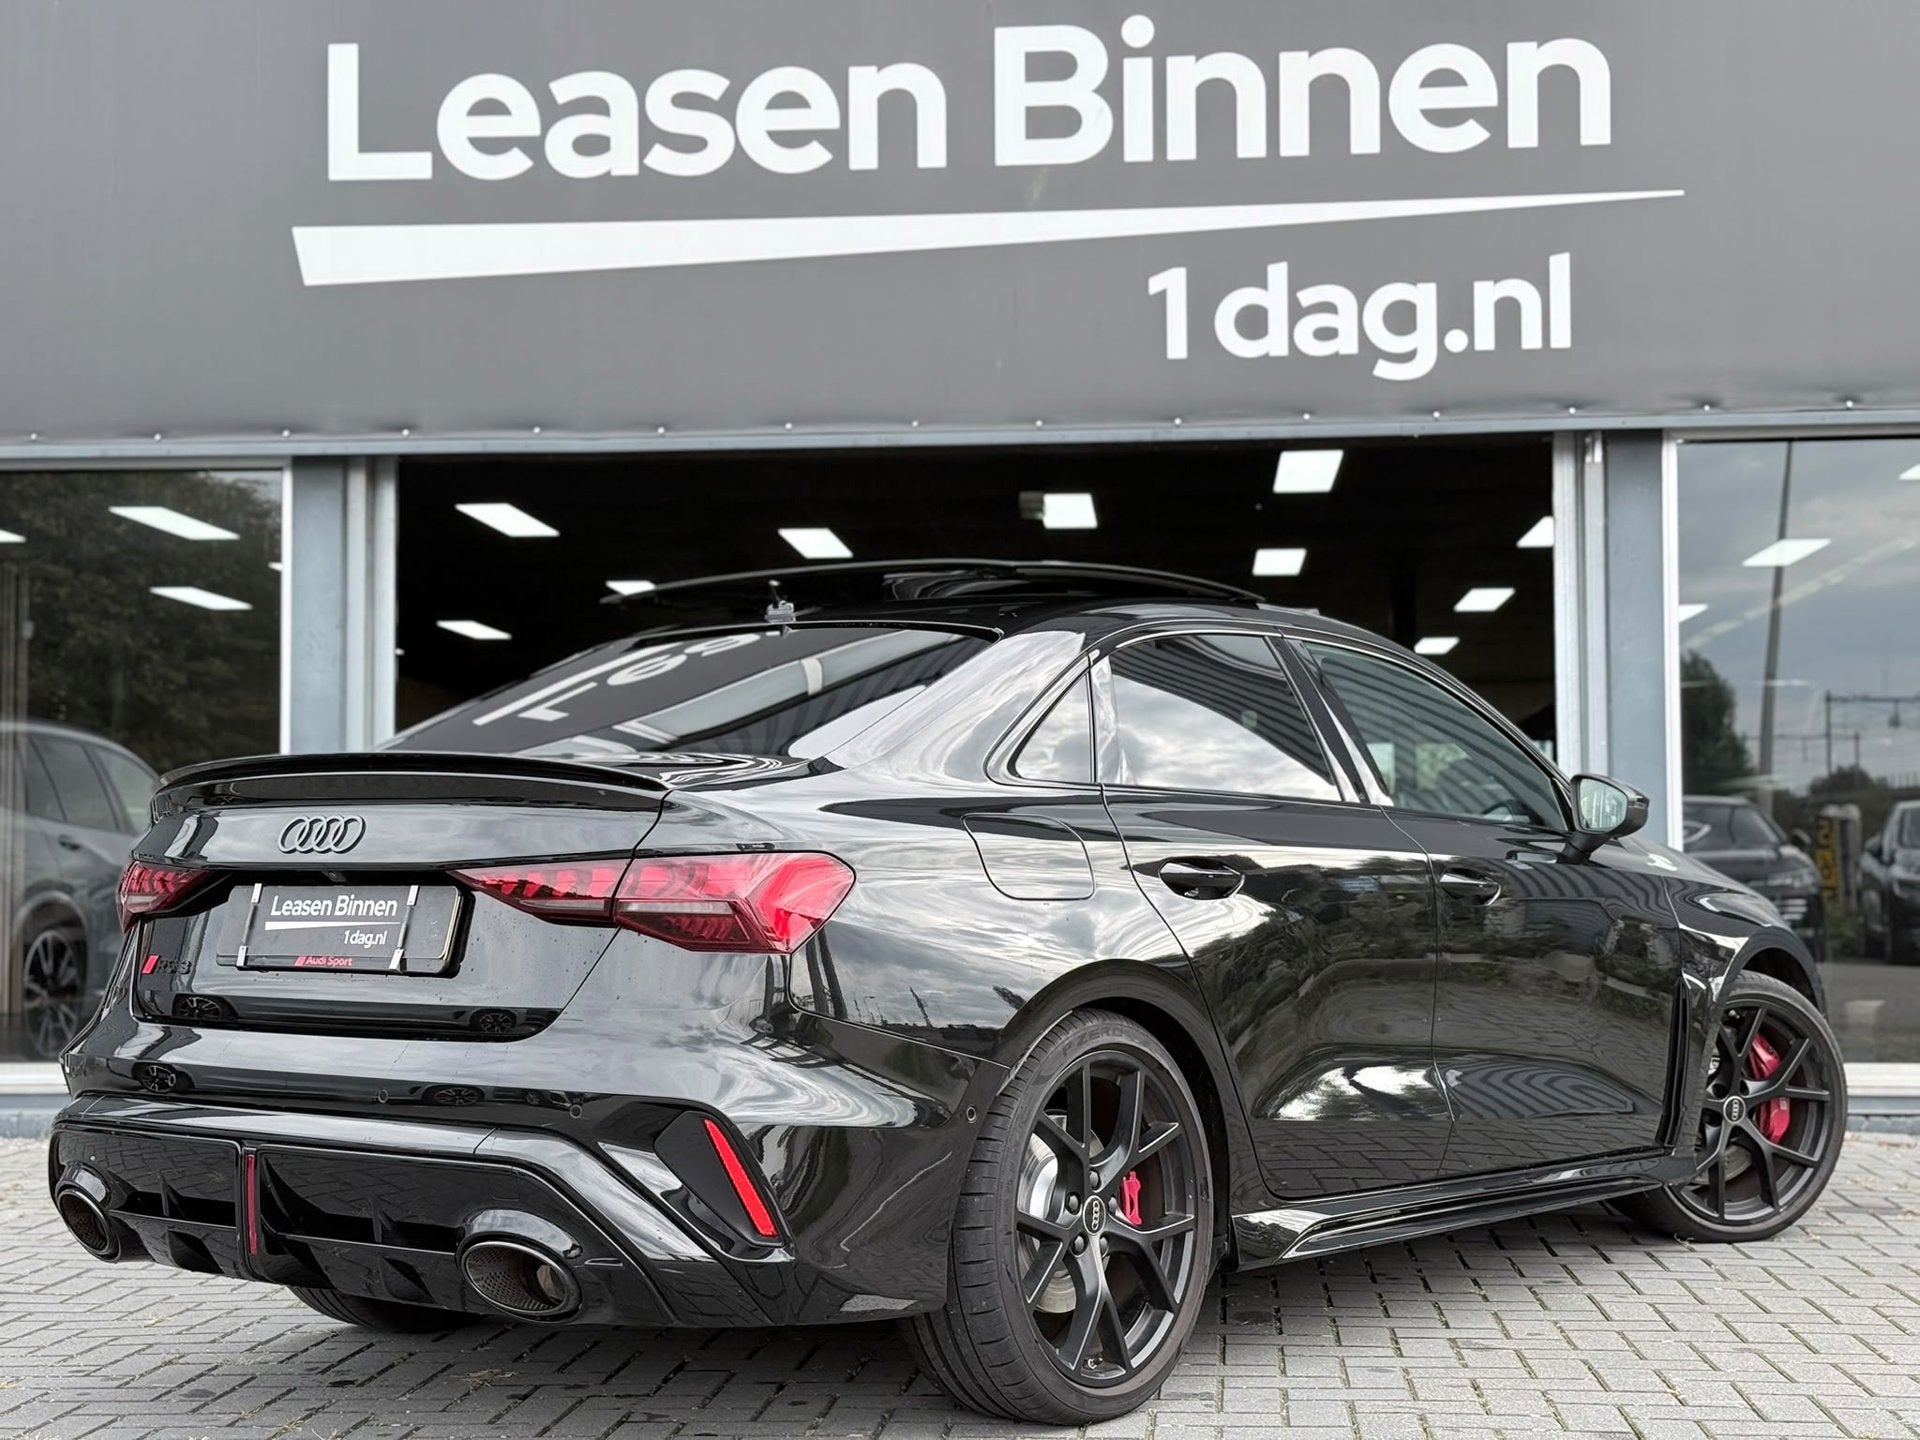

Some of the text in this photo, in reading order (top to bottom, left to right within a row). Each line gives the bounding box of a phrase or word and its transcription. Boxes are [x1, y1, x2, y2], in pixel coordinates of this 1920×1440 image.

[327, 14, 1612, 182] Leasen Binnen
[270, 894, 398, 917] Leasen Binnen
[304, 956, 353, 968] Audi Sport
